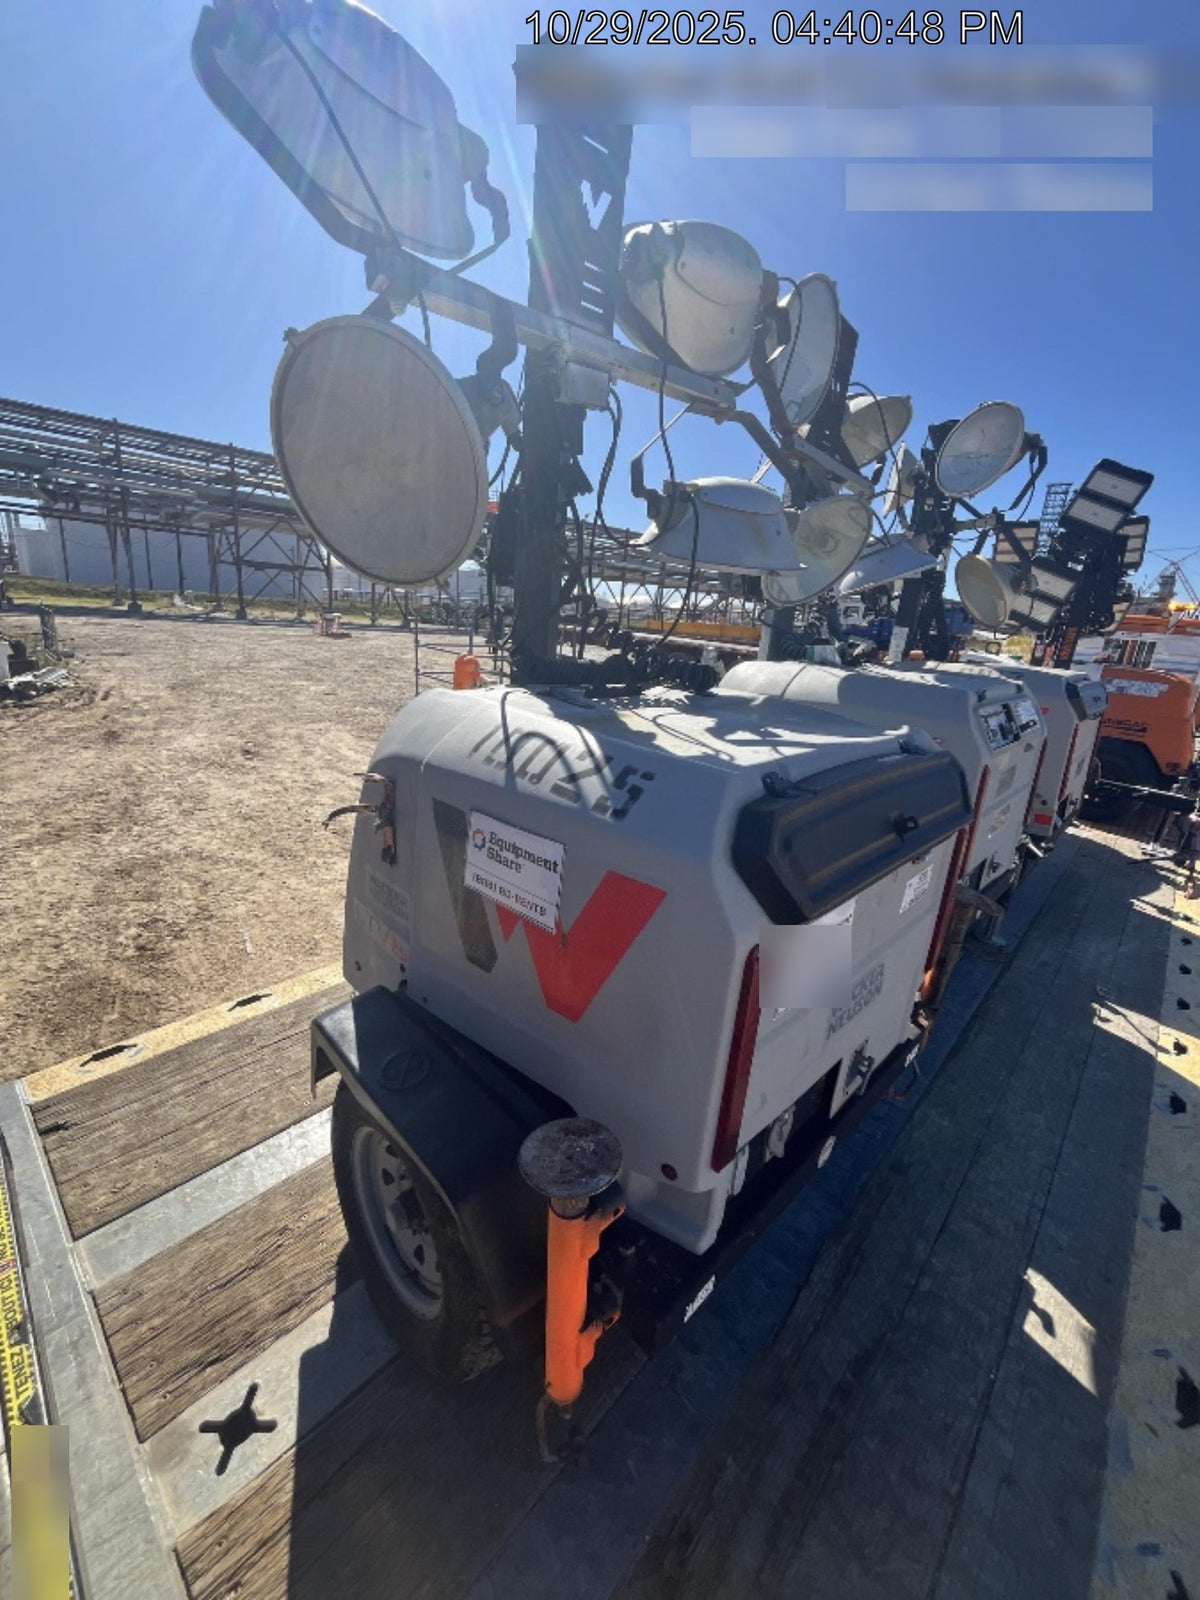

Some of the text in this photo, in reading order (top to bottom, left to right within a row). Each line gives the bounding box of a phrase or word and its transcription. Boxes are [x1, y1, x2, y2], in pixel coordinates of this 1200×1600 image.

[487, 846, 521, 874] Share
[488, 831, 559, 873] Equipment
[10, 1345, 29, 1399] TENEZ
